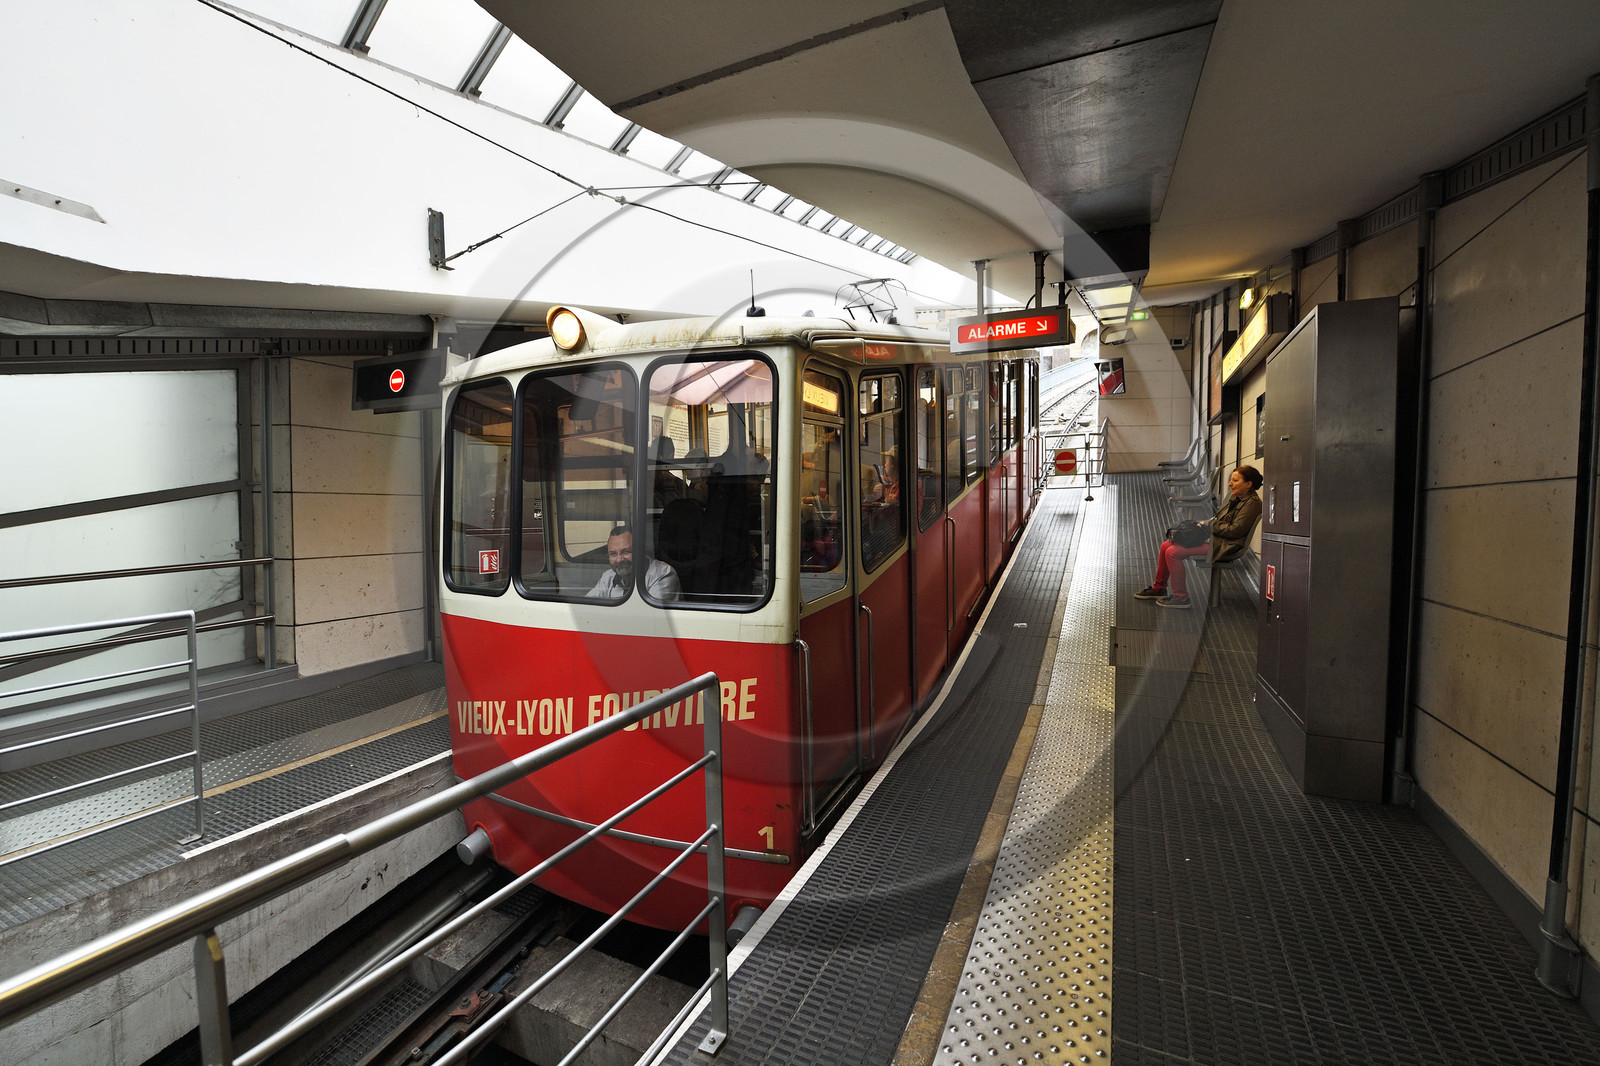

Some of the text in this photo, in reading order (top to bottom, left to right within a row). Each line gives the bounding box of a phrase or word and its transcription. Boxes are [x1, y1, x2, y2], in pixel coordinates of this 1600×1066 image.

[968, 322, 1026, 340] ALARME
[457, 677, 758, 735] VIEUX-LYON FOURVIRE
[757, 826, 774, 850] 1
